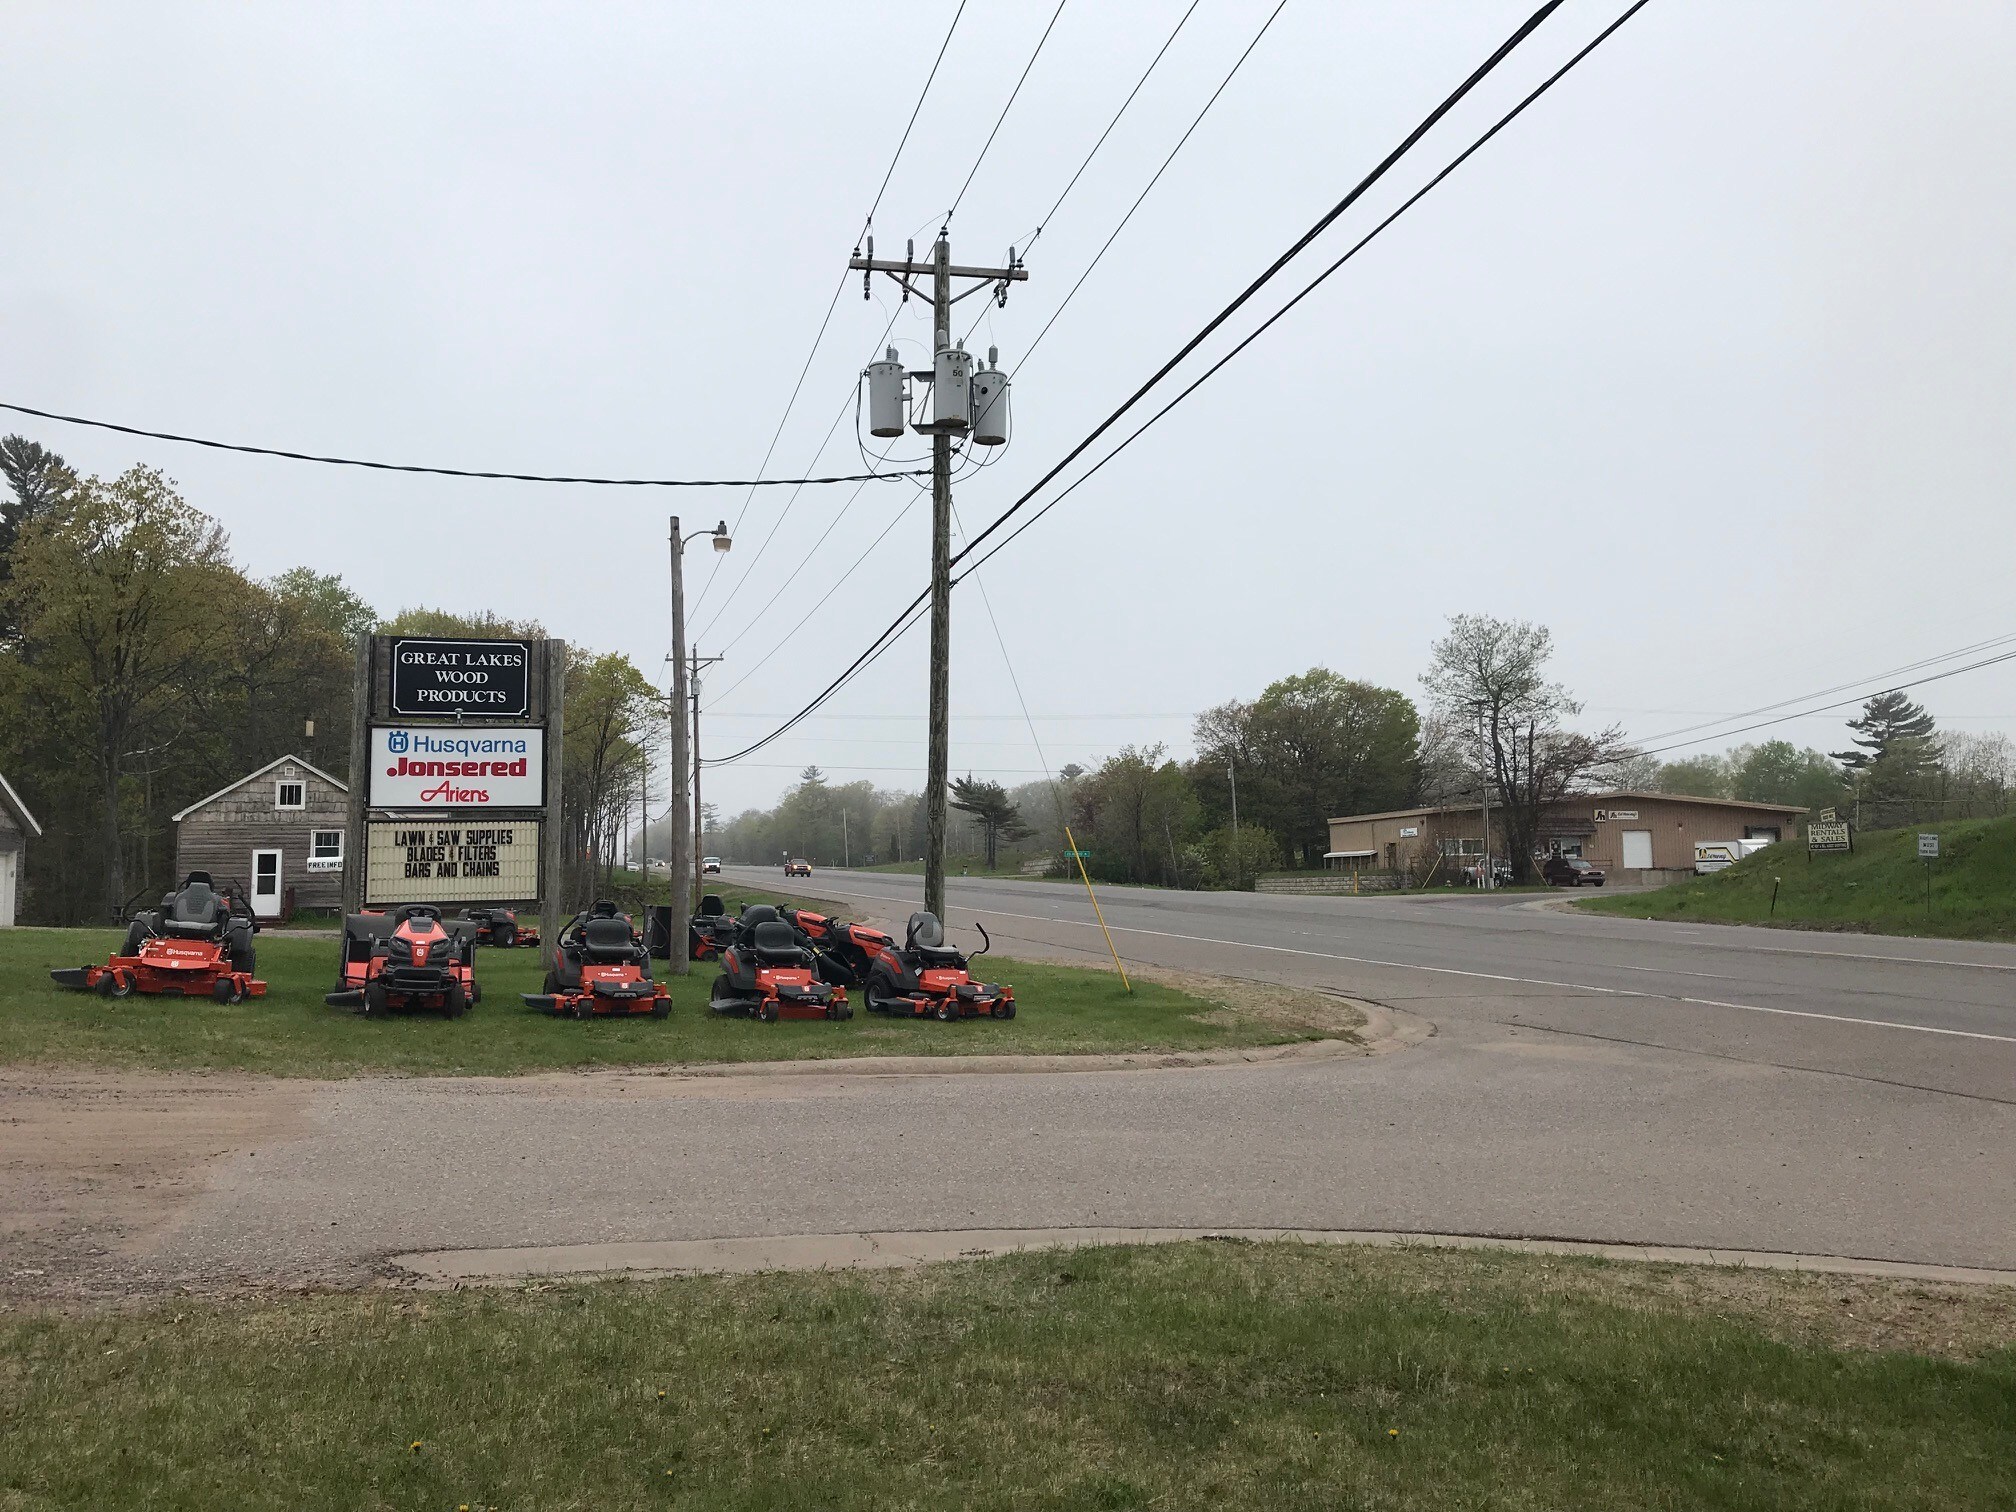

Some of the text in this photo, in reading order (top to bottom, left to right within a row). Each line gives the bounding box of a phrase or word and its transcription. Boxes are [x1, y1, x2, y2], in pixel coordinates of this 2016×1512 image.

[401, 652, 522, 667] GREAT LAKES
[435, 671, 488, 684] WOOD
[417, 689, 506, 703] PRODUCTS
[414, 735, 526, 757] Husqvarna
[387, 757, 527, 777] Jonsered
[420, 780, 490, 802] Ariens
[1811, 821, 1843, 829] MIDWAY
[1811, 828, 1846, 836] RENTALS
[395, 830, 425, 846] LAWN
[437, 830, 460, 845] SAW
[466, 829, 513, 845] SUPPLIES
[406, 846, 445, 862] BLADES
[458, 846, 496, 861] FILTERS
[404, 861, 499, 878] BARS AND CHAINS
[173, 948, 203, 956] Husqvarna
